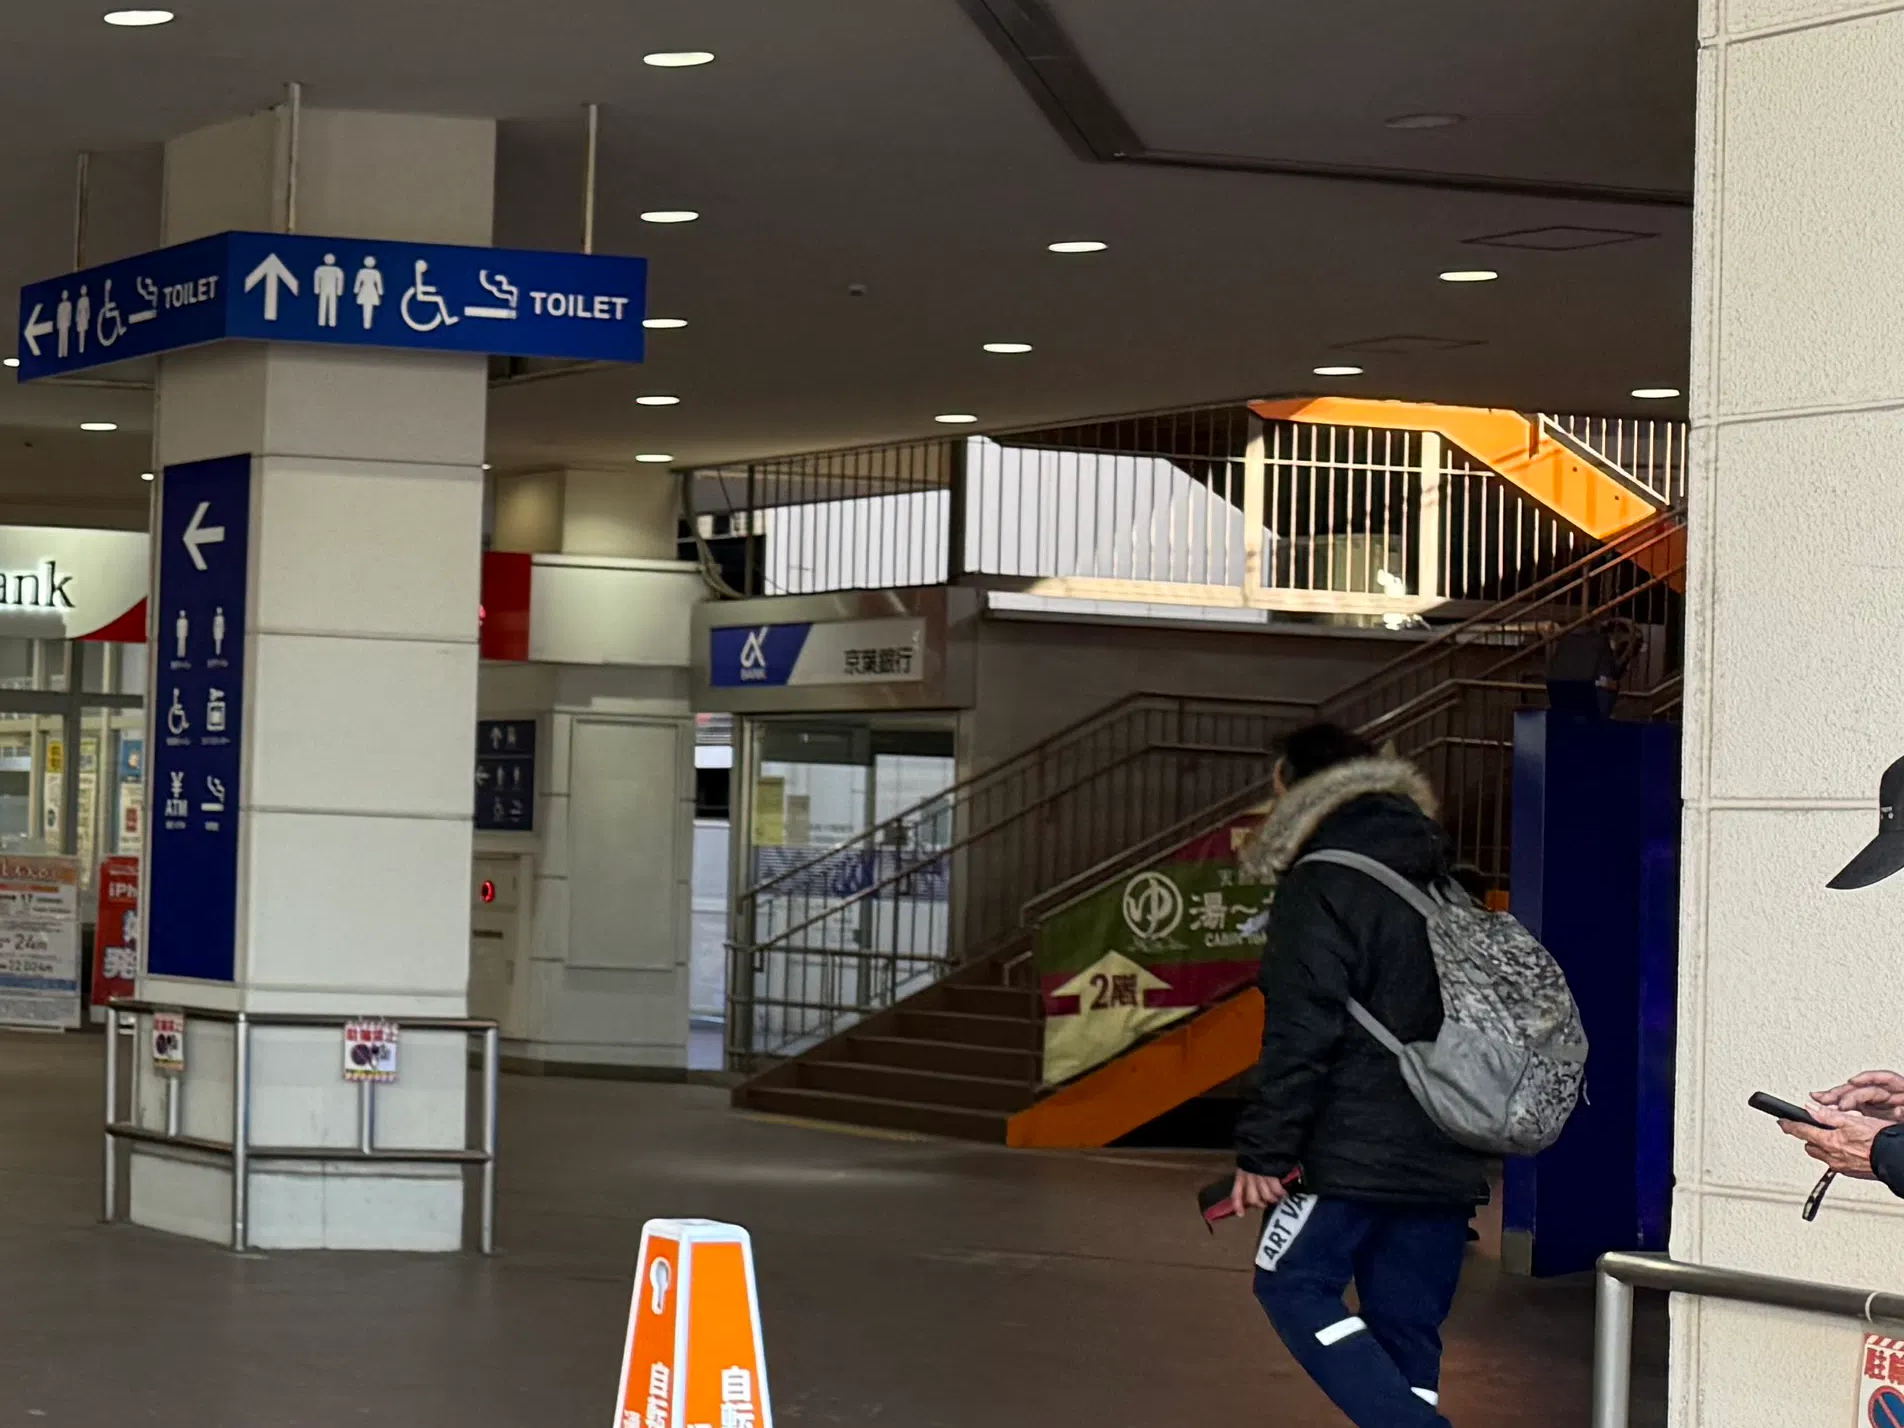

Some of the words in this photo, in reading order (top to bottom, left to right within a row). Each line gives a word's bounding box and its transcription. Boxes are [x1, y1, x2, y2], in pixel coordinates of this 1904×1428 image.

[163, 275, 218, 310] TOILET
[532, 291, 629, 321] TOILET
[843, 646, 913, 676] 京葉銀行
[164, 799, 188, 817] ATM
[1263, 1218, 1292, 1260] ART
